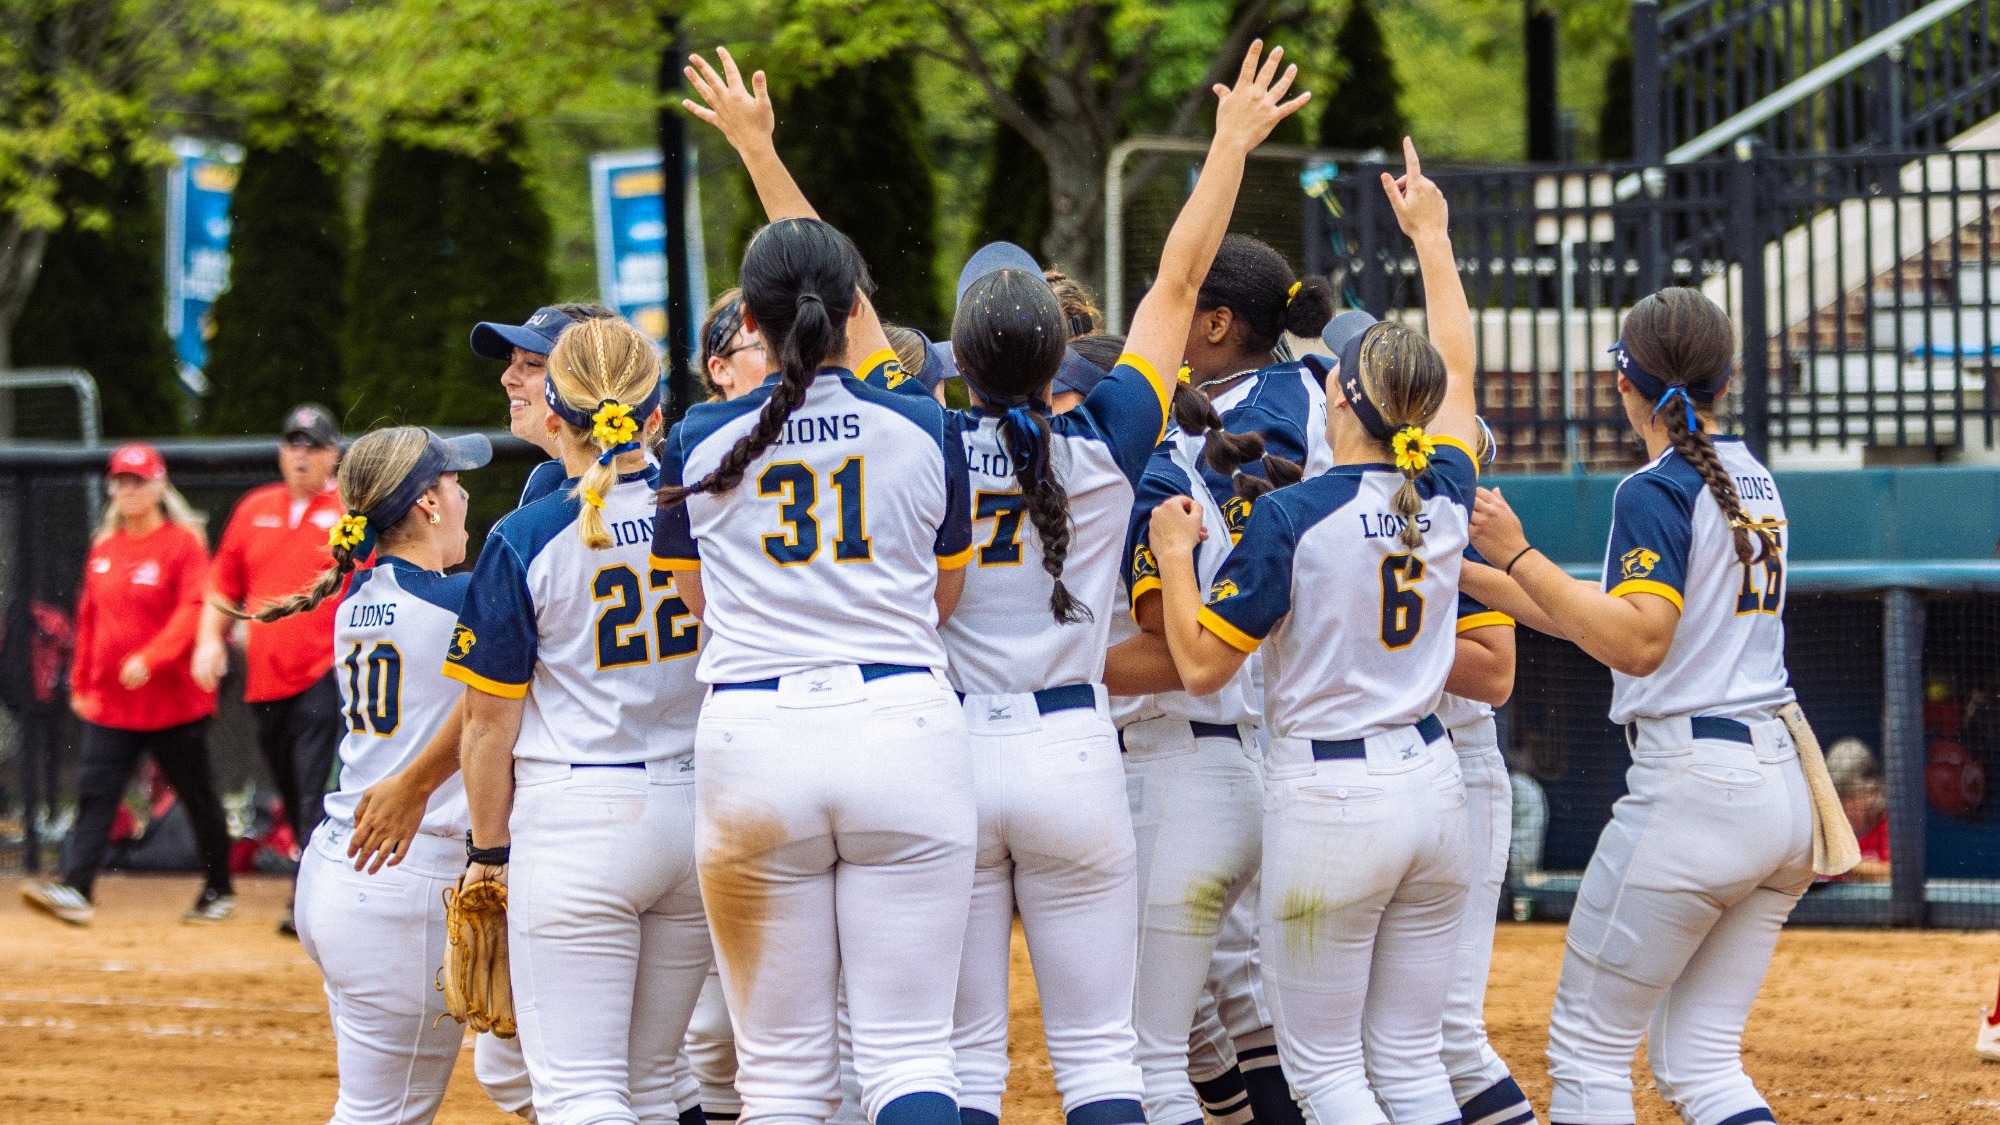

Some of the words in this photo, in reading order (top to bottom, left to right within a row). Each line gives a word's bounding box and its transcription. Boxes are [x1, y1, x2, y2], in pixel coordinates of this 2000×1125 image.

[773, 413, 860, 446] IONS
[967, 445, 1014, 478] LIO
[1735, 476, 1774, 501] IONS
[610, 515, 656, 547] ION
[756, 455, 874, 568] 31
[972, 490, 1027, 568] 7
[348, 602, 397, 628] LIONS
[590, 562, 701, 672] 22
[1378, 552, 1427, 653] 6
[342, 639, 403, 738] 10
